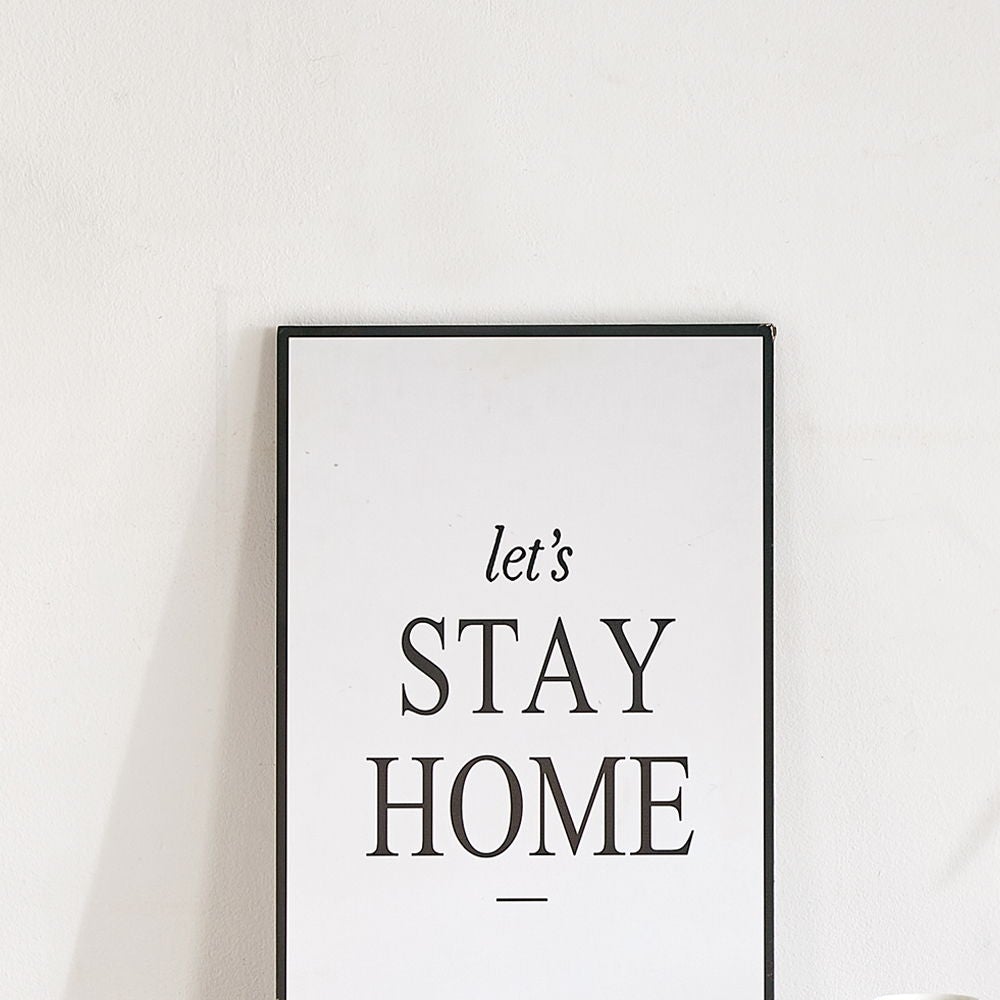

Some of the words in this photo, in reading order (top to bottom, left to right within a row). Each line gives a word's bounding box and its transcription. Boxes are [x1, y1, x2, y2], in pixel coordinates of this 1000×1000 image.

[485, 525, 573, 582] let's
[401, 616, 676, 716] STAY
[366, 754, 694, 858] HOME
